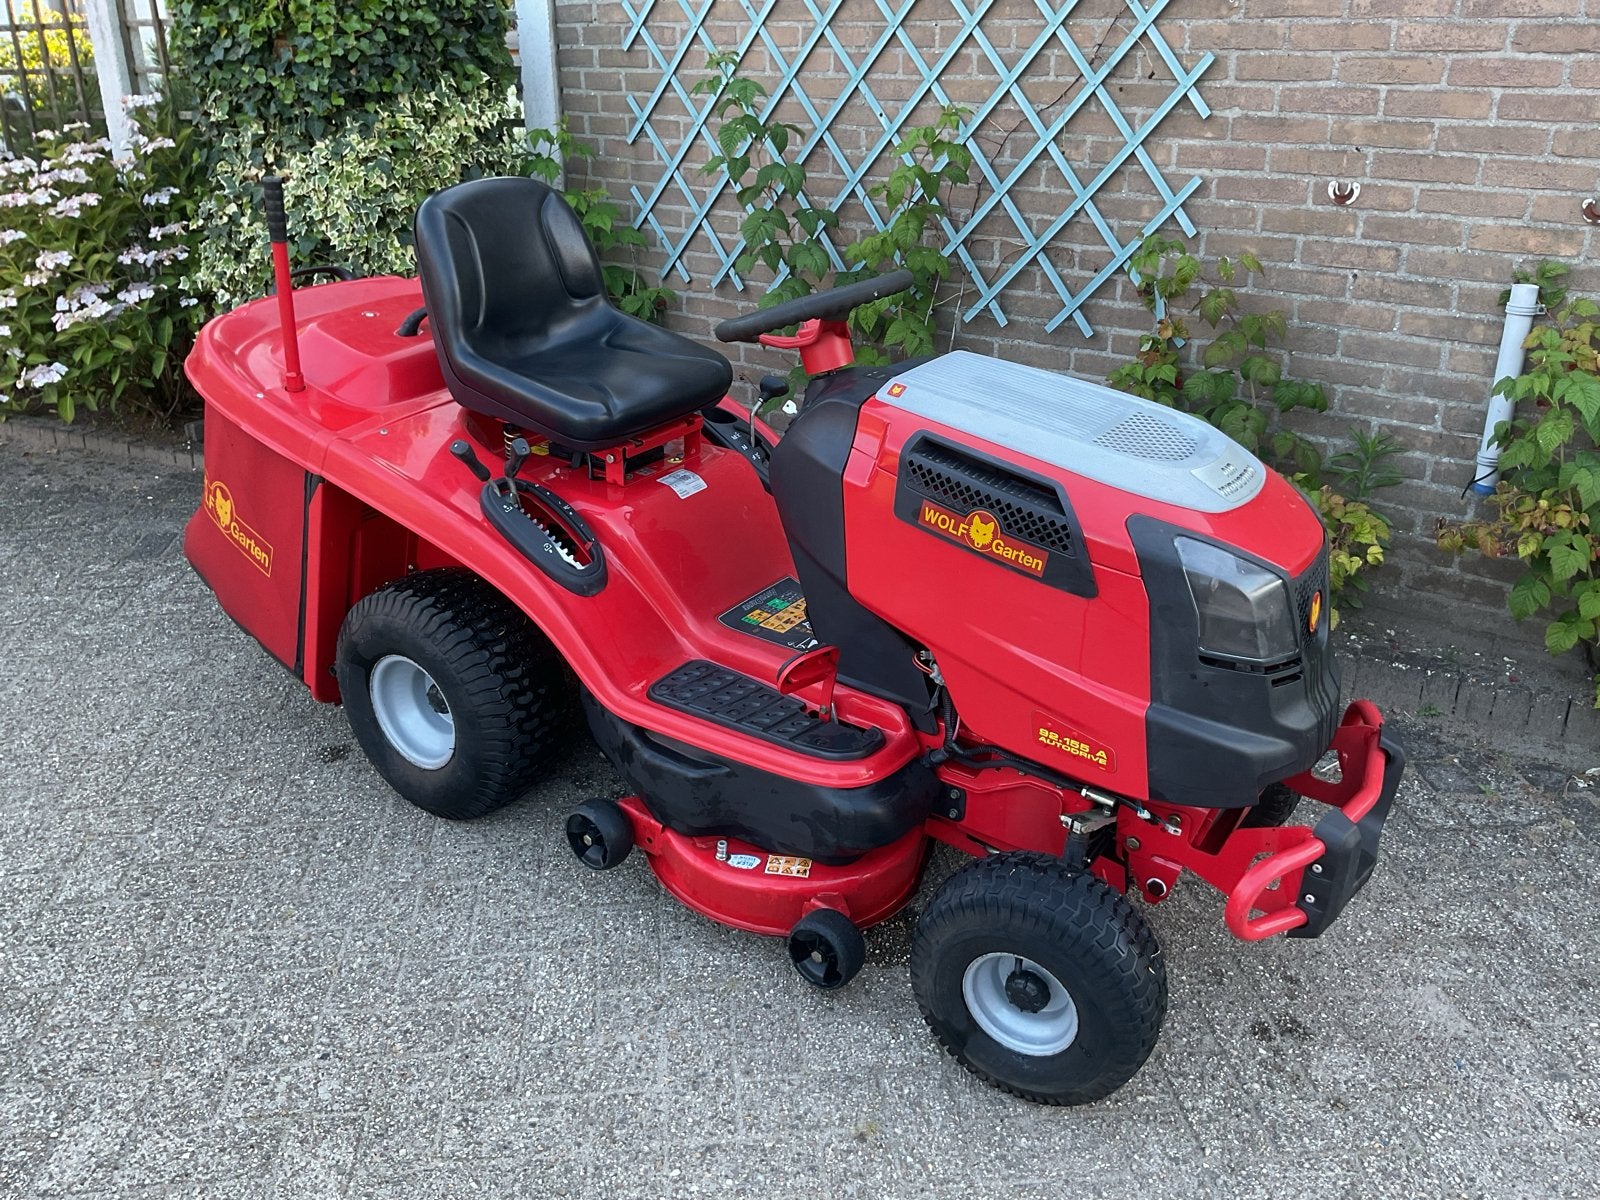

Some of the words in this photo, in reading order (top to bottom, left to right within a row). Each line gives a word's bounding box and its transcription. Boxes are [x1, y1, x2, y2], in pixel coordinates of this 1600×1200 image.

[230, 521, 269, 568] Garten
[925, 506, 969, 537] WOLF
[991, 539, 1043, 571] Garten
[1038, 727, 1090, 753] 92.155
[1095, 750, 1108, 760] A
[1038, 736, 1107, 766] AUTODRIVE
